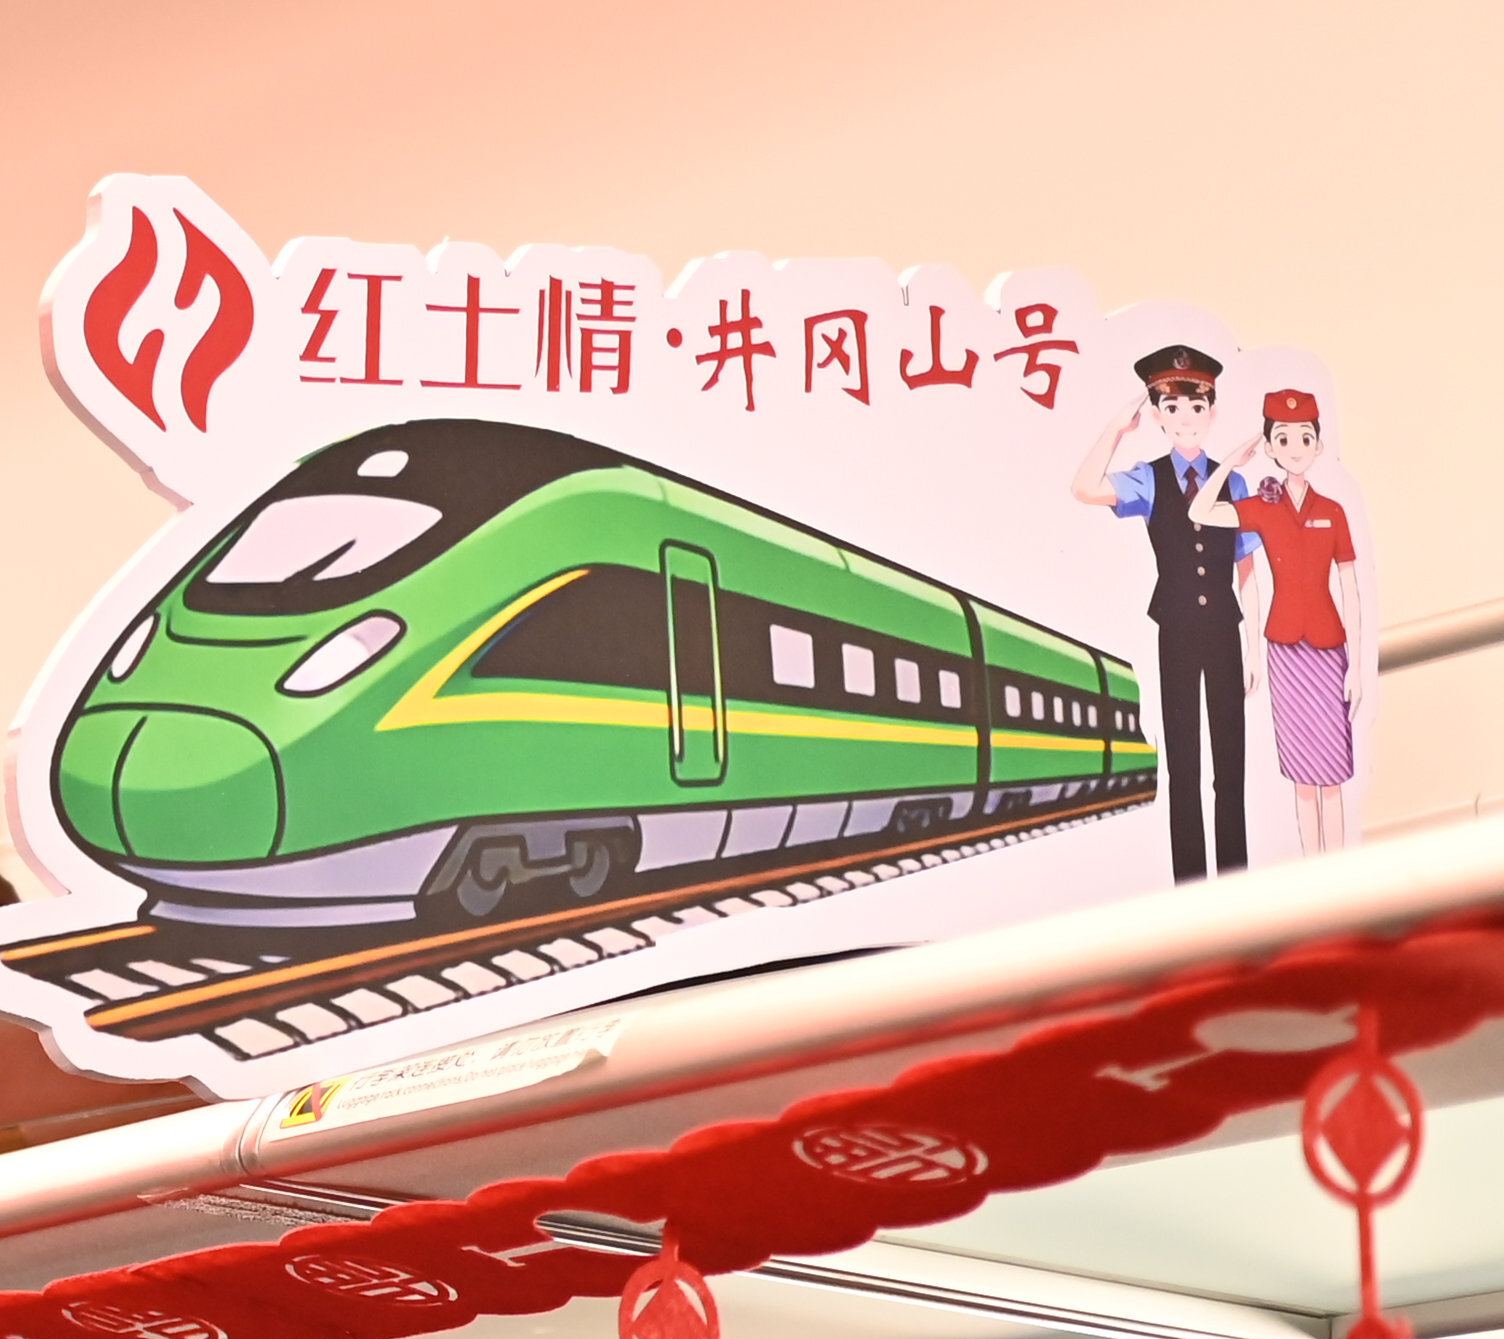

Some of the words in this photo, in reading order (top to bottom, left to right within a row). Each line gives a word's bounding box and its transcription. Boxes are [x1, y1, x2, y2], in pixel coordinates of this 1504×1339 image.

[297, 266, 1081, 412] 红土情·井冈山号
